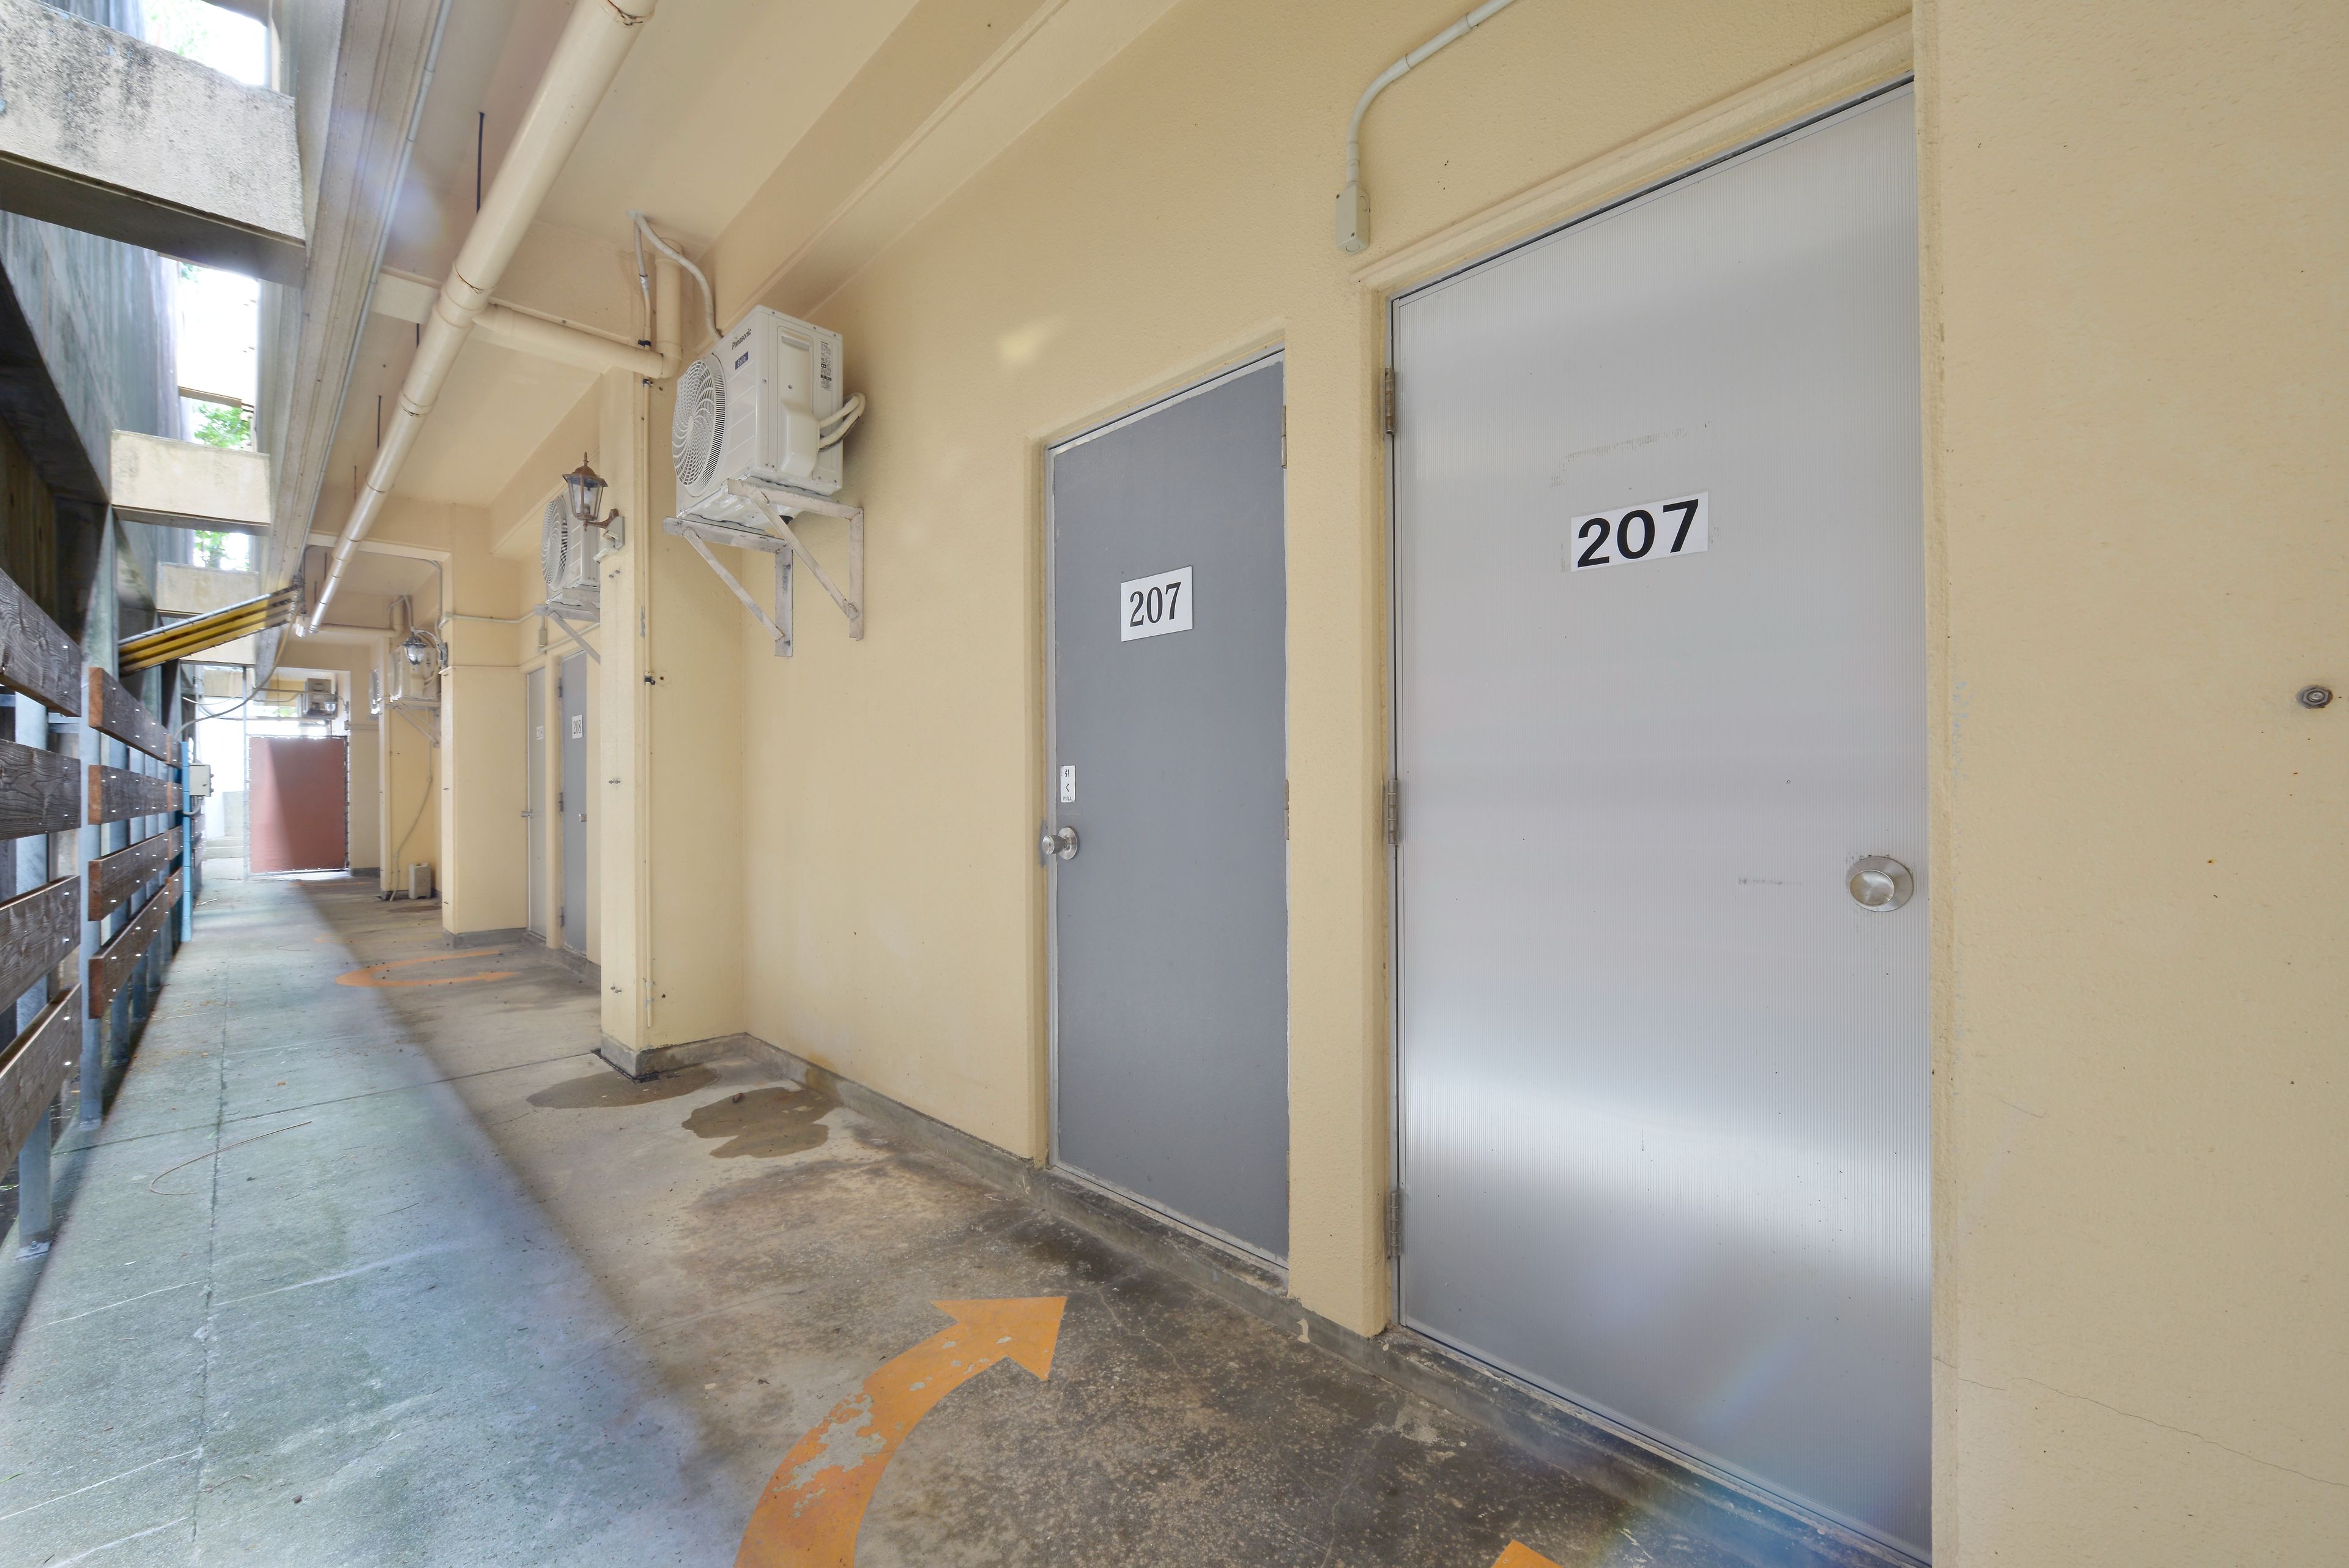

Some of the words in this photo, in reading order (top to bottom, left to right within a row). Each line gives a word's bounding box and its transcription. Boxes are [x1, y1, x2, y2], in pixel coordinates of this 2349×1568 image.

[732, 329, 751, 350] Panasonic
[1577, 499, 1699, 568] 207
[1129, 581, 1181, 628] 207
[1064, 769, 1070, 792] 引く
